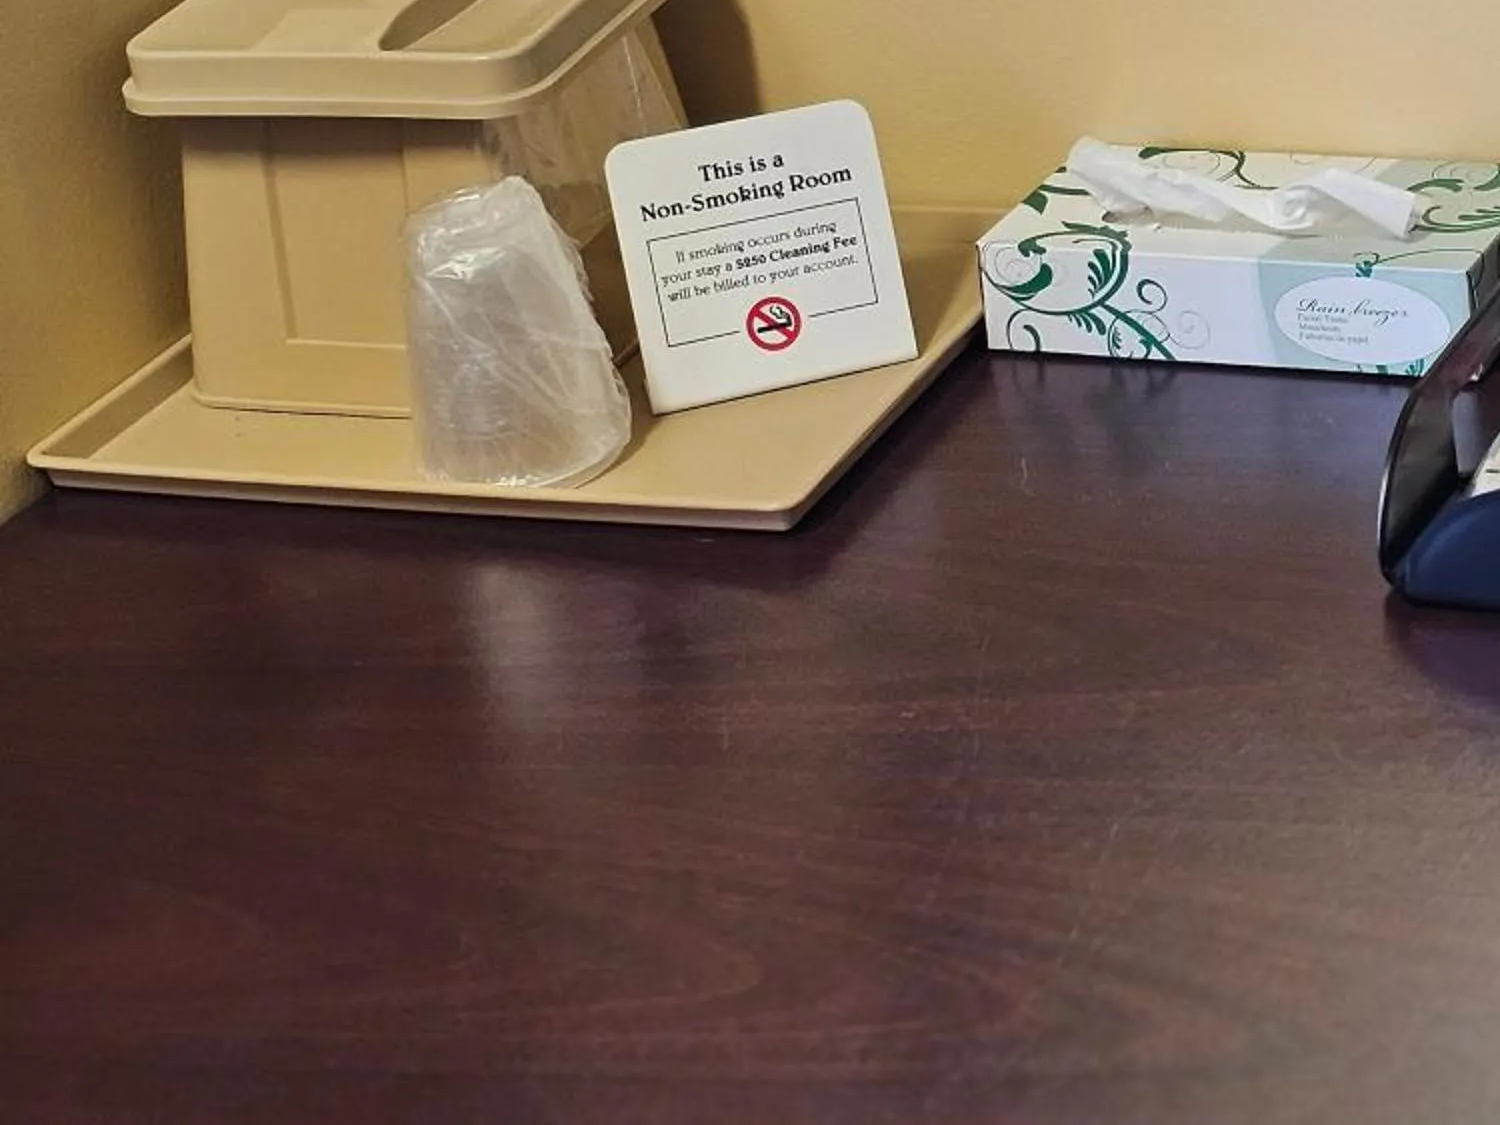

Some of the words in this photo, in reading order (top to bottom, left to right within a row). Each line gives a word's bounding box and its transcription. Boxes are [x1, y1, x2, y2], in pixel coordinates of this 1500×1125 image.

[698, 162, 745, 182] This
[749, 156, 767, 173] is
[772, 154, 785, 168] a
[639, 180, 786, 222] Non-Smoking
[788, 168, 853, 192] Room
[661, 271, 693, 288] your
[695, 263, 722, 280] stay
[725, 261, 733, 273] a
[736, 253, 768, 271] $250
[769, 240, 831, 262] Cleaning
[833, 236, 858, 250] Fee
[688, 239, 745, 261] smoking
[747, 232, 791, 249] occurs
[793, 221, 837, 239] during
[668, 286, 692, 303] will
[694, 284, 711, 297] be
[713, 274, 750, 292] billed
[752, 272, 768, 284] to
[769, 266, 801, 285] your
[803, 254, 859, 275] account.
[1296, 299, 1345, 314] Rain
